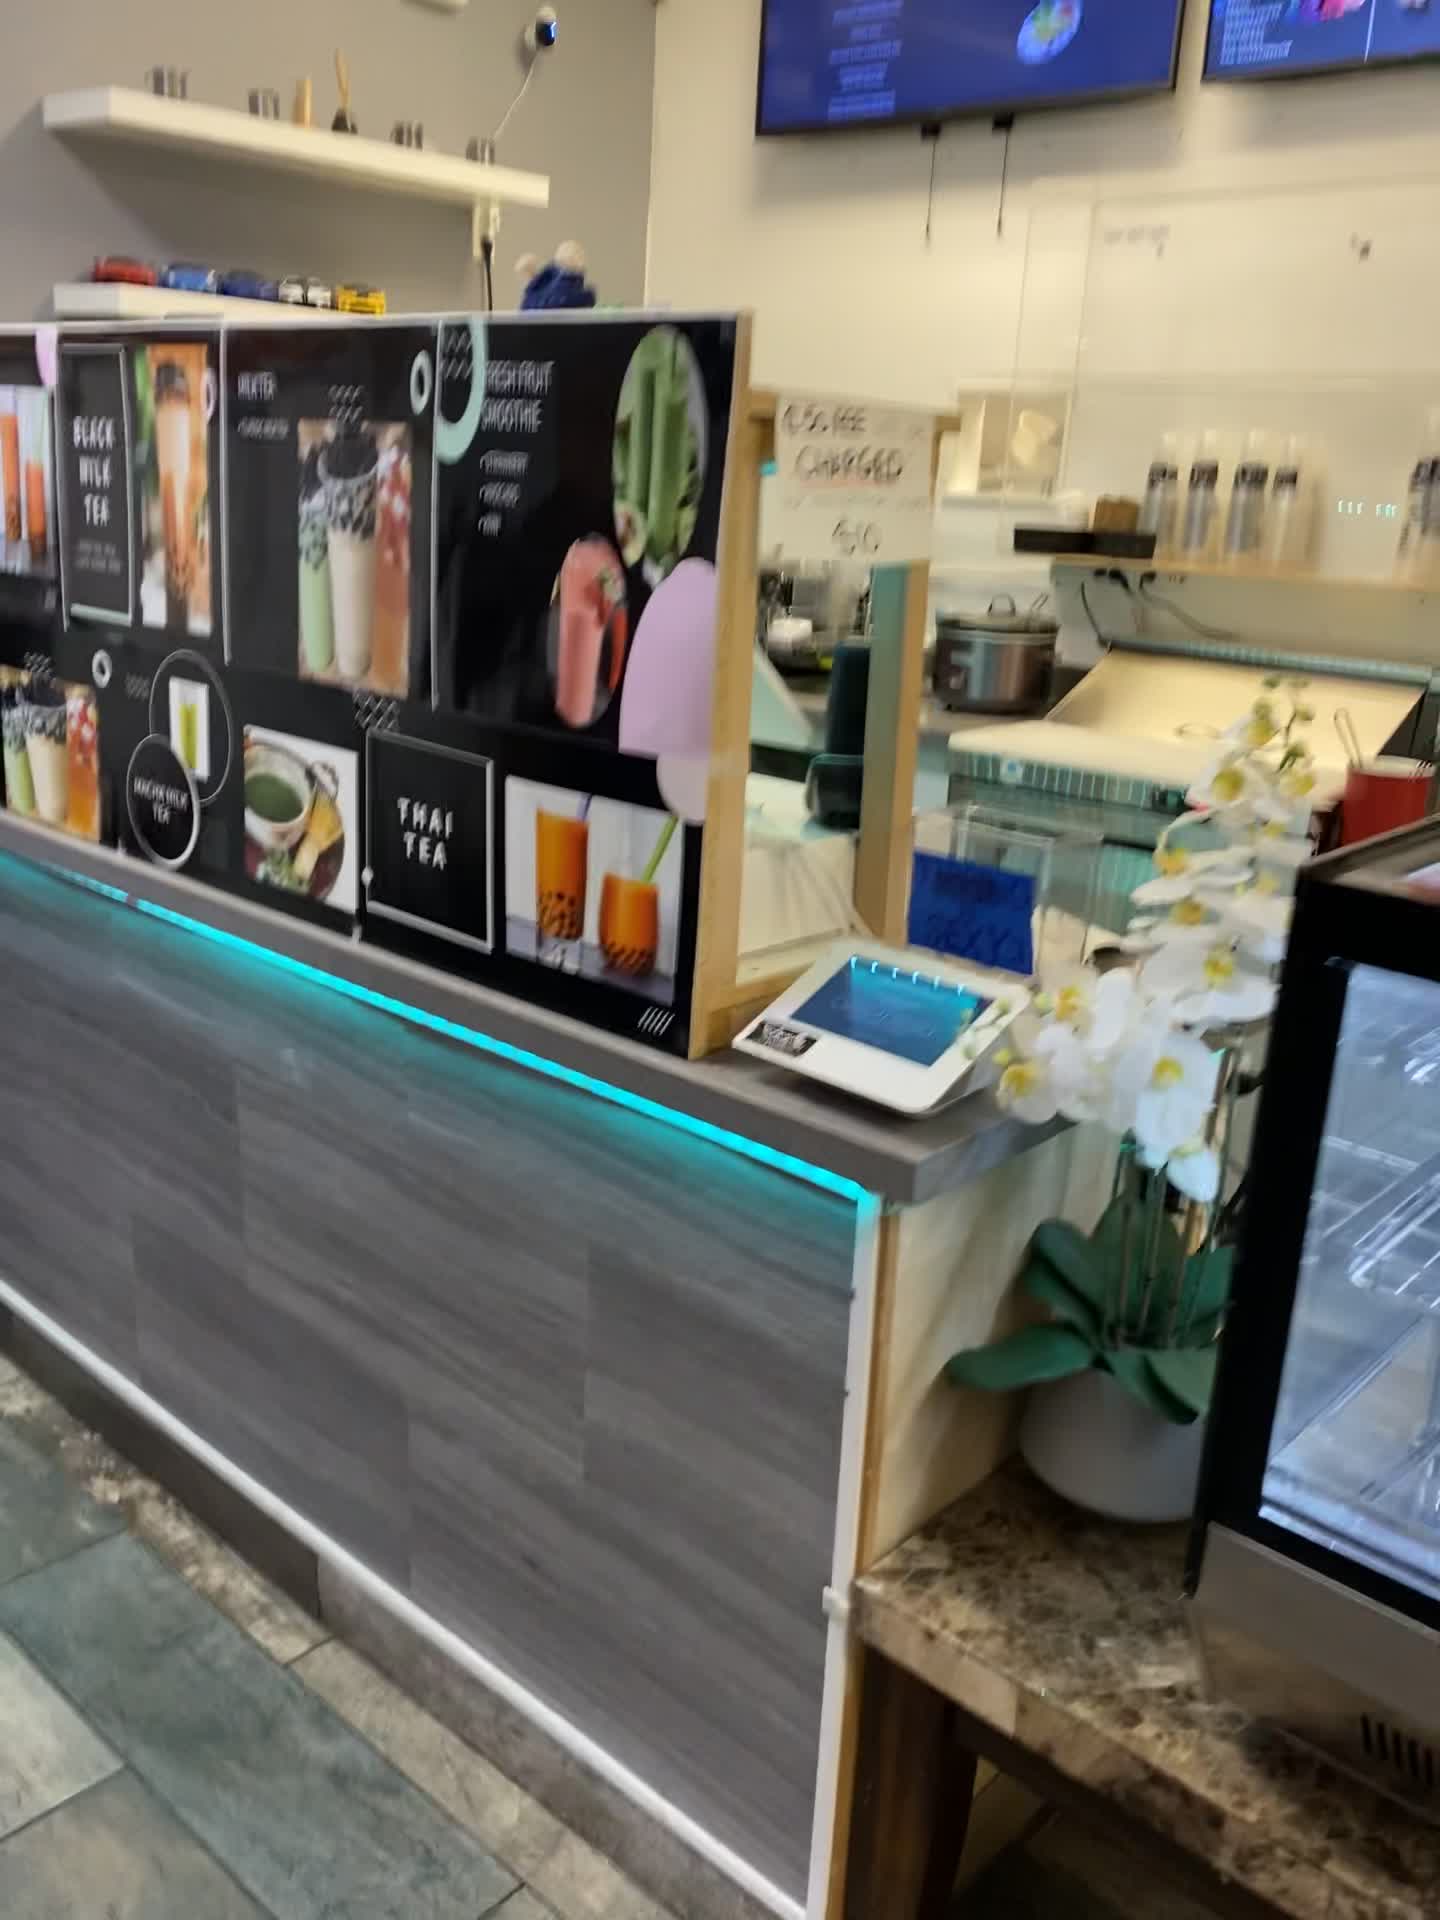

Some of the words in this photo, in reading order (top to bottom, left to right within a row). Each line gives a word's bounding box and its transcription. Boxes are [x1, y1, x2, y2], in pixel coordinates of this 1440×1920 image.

[73, 415, 115, 449] BLACK
[480, 399, 543, 432] SMOOTHIE
[79, 455, 112, 489] MILK
[84, 493, 109, 527] TEA
[397, 797, 453, 840] THAI
[403, 831, 447, 870] TEA
